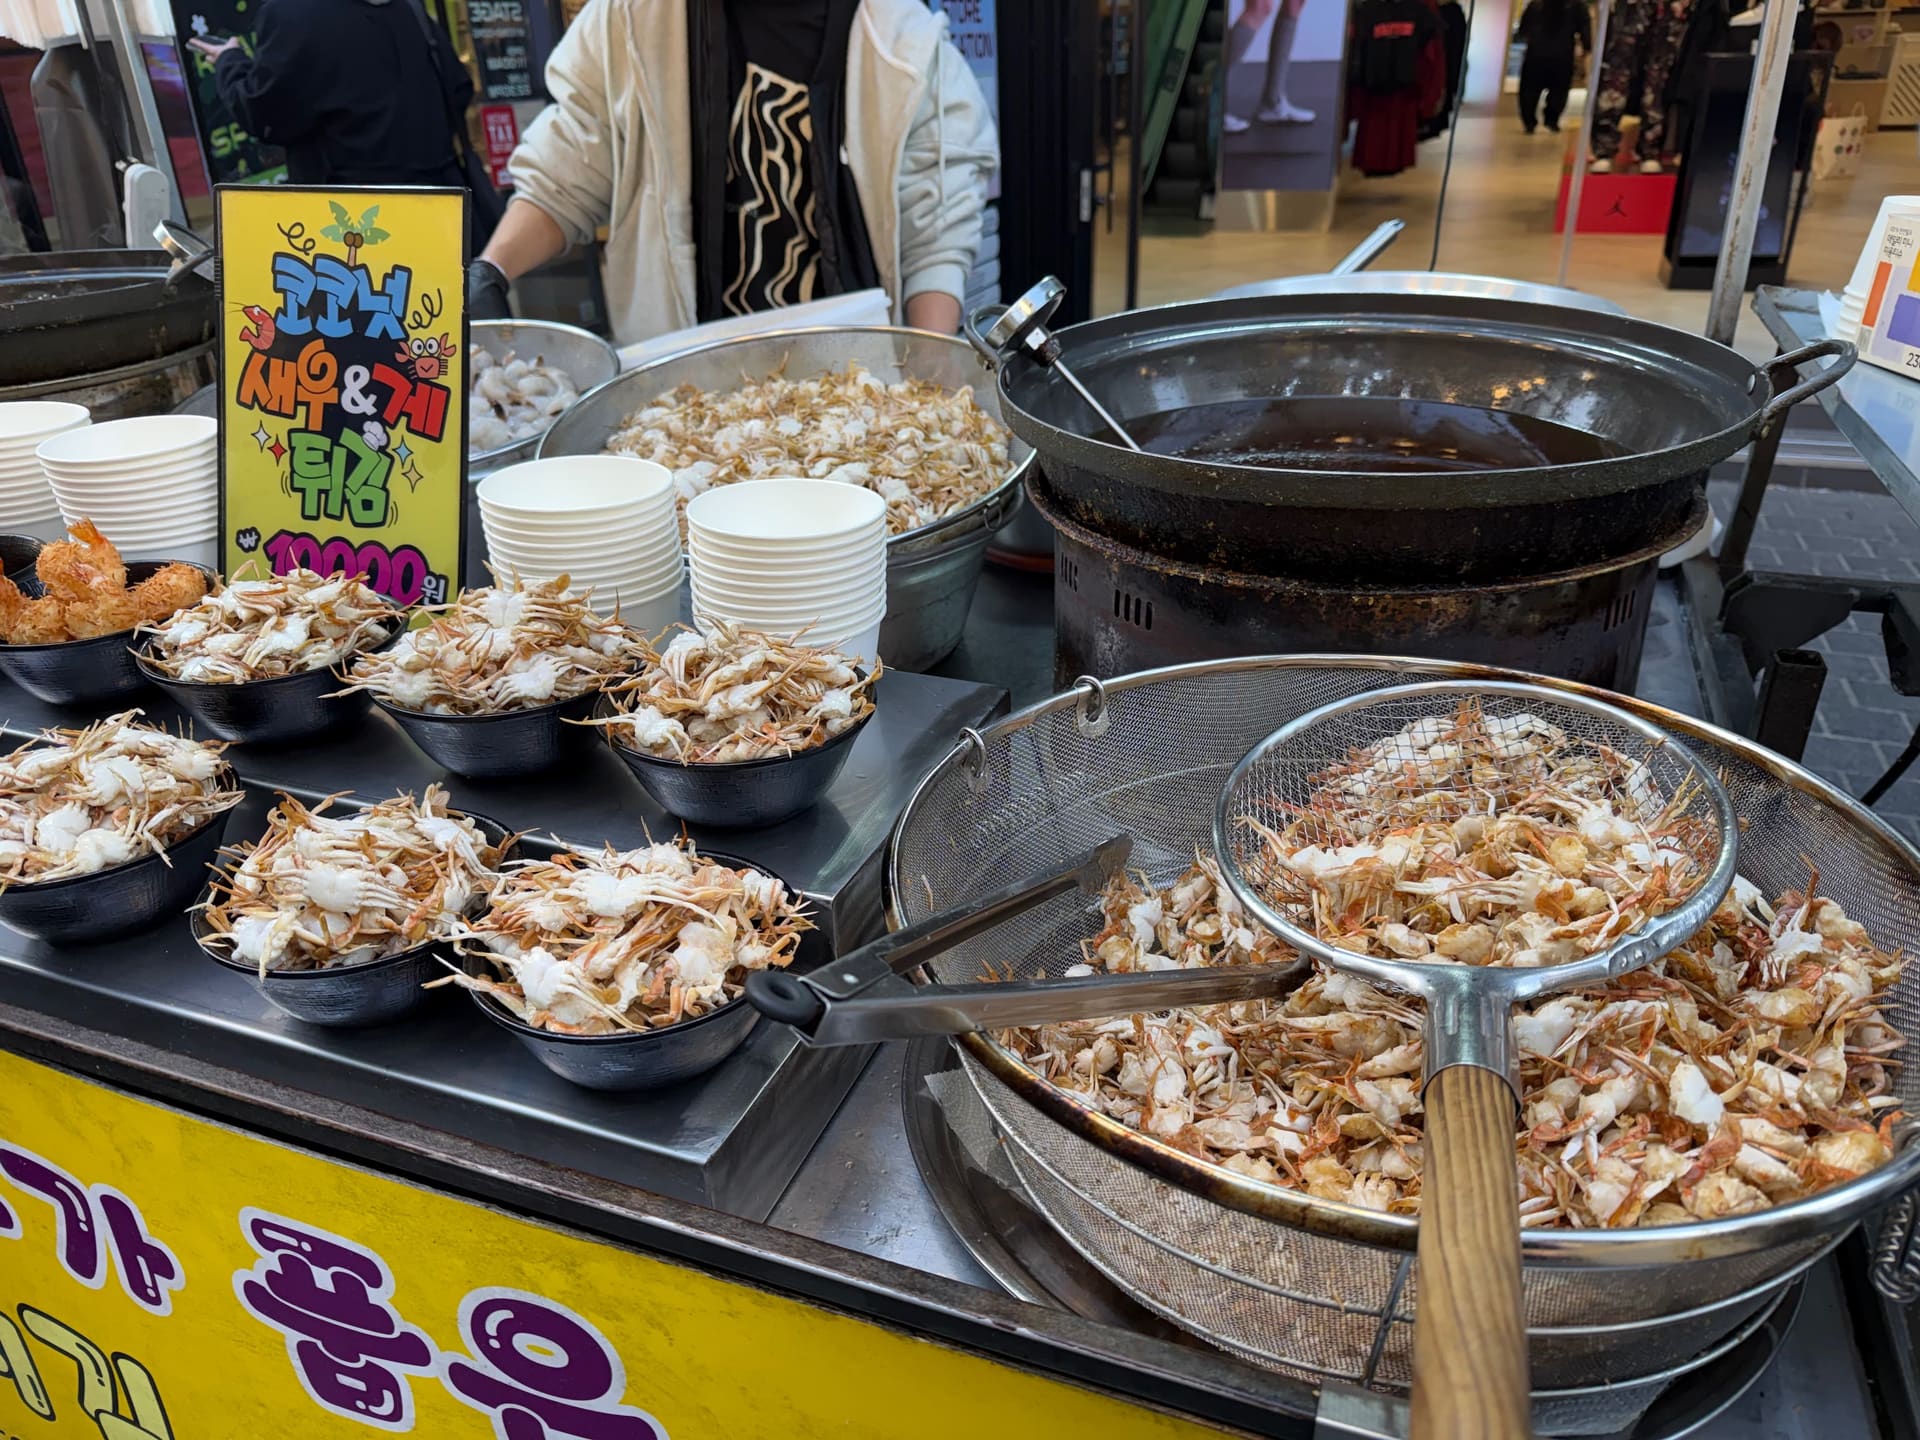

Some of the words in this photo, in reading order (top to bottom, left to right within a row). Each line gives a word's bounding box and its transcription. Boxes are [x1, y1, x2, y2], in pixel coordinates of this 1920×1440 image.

[273, 253, 411, 341] 코코넛
[289, 427, 394, 527] 튀김
[0, 1140, 186, 1316] 가
